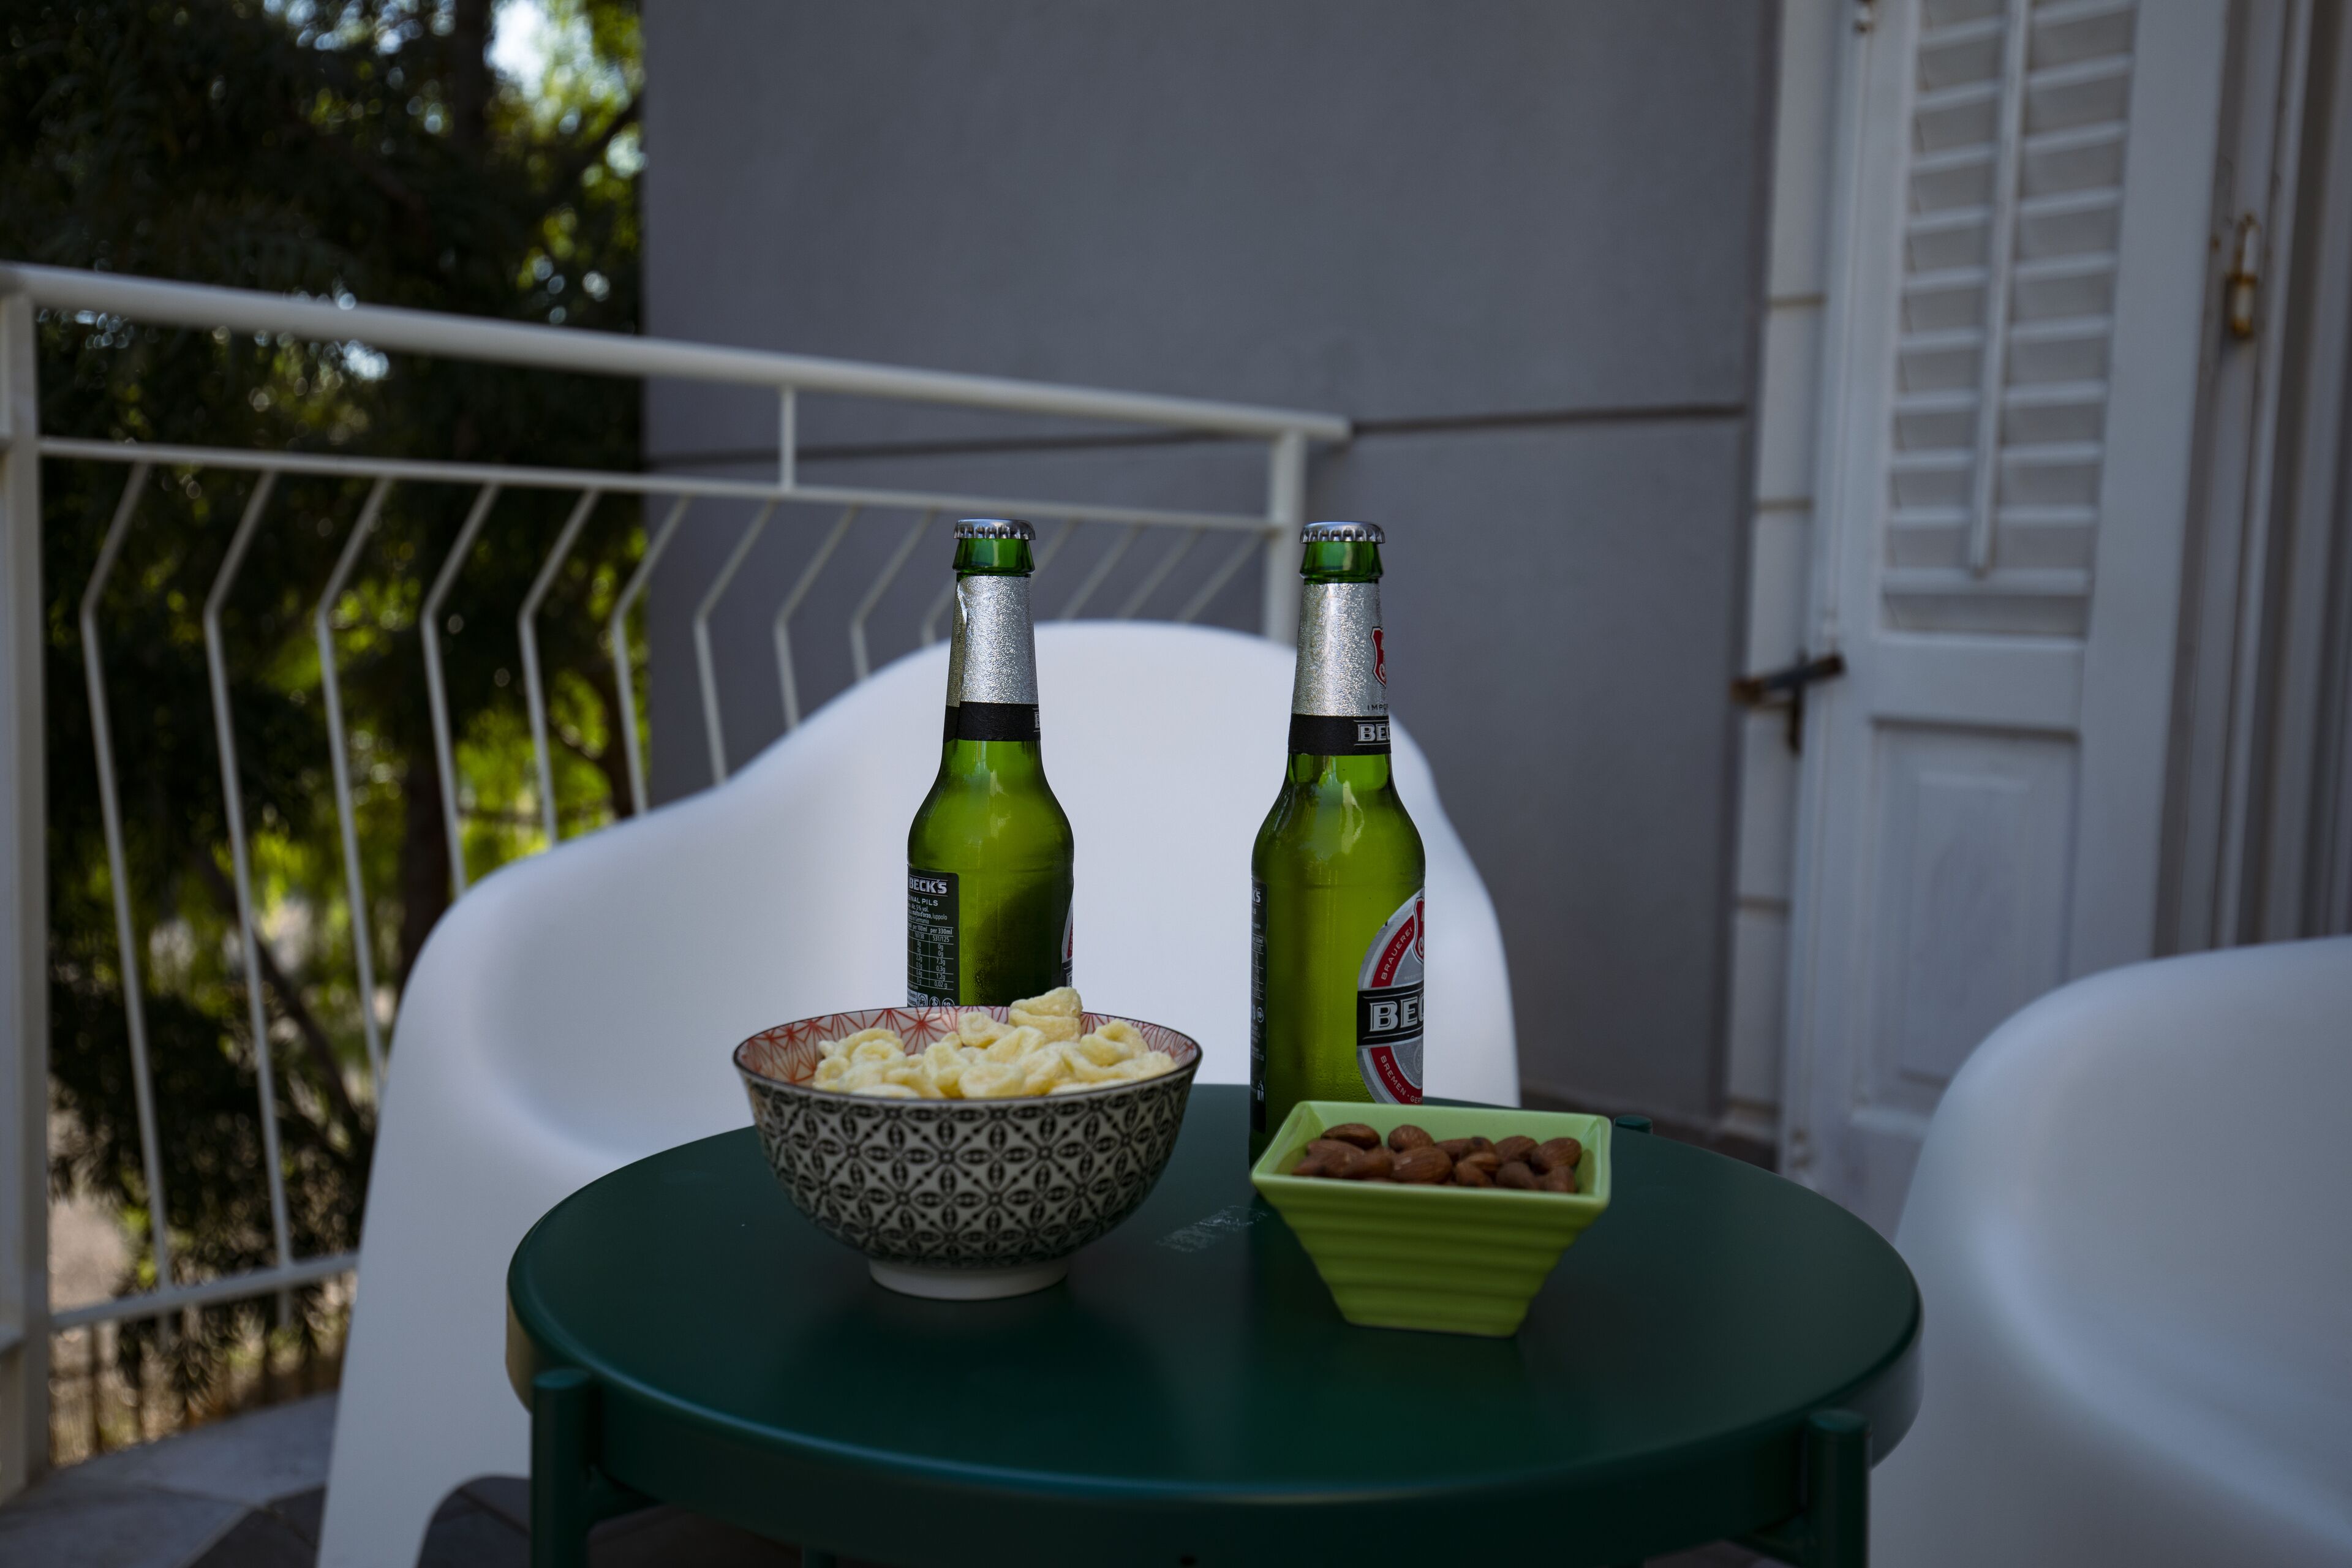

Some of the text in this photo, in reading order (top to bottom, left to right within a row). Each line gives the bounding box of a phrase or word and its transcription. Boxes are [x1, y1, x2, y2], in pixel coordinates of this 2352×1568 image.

[909, 876, 947, 894] BECK'S
[1381, 926, 1412, 980] BRAUEREI
[1380, 1055, 1406, 1096] BREMEN
